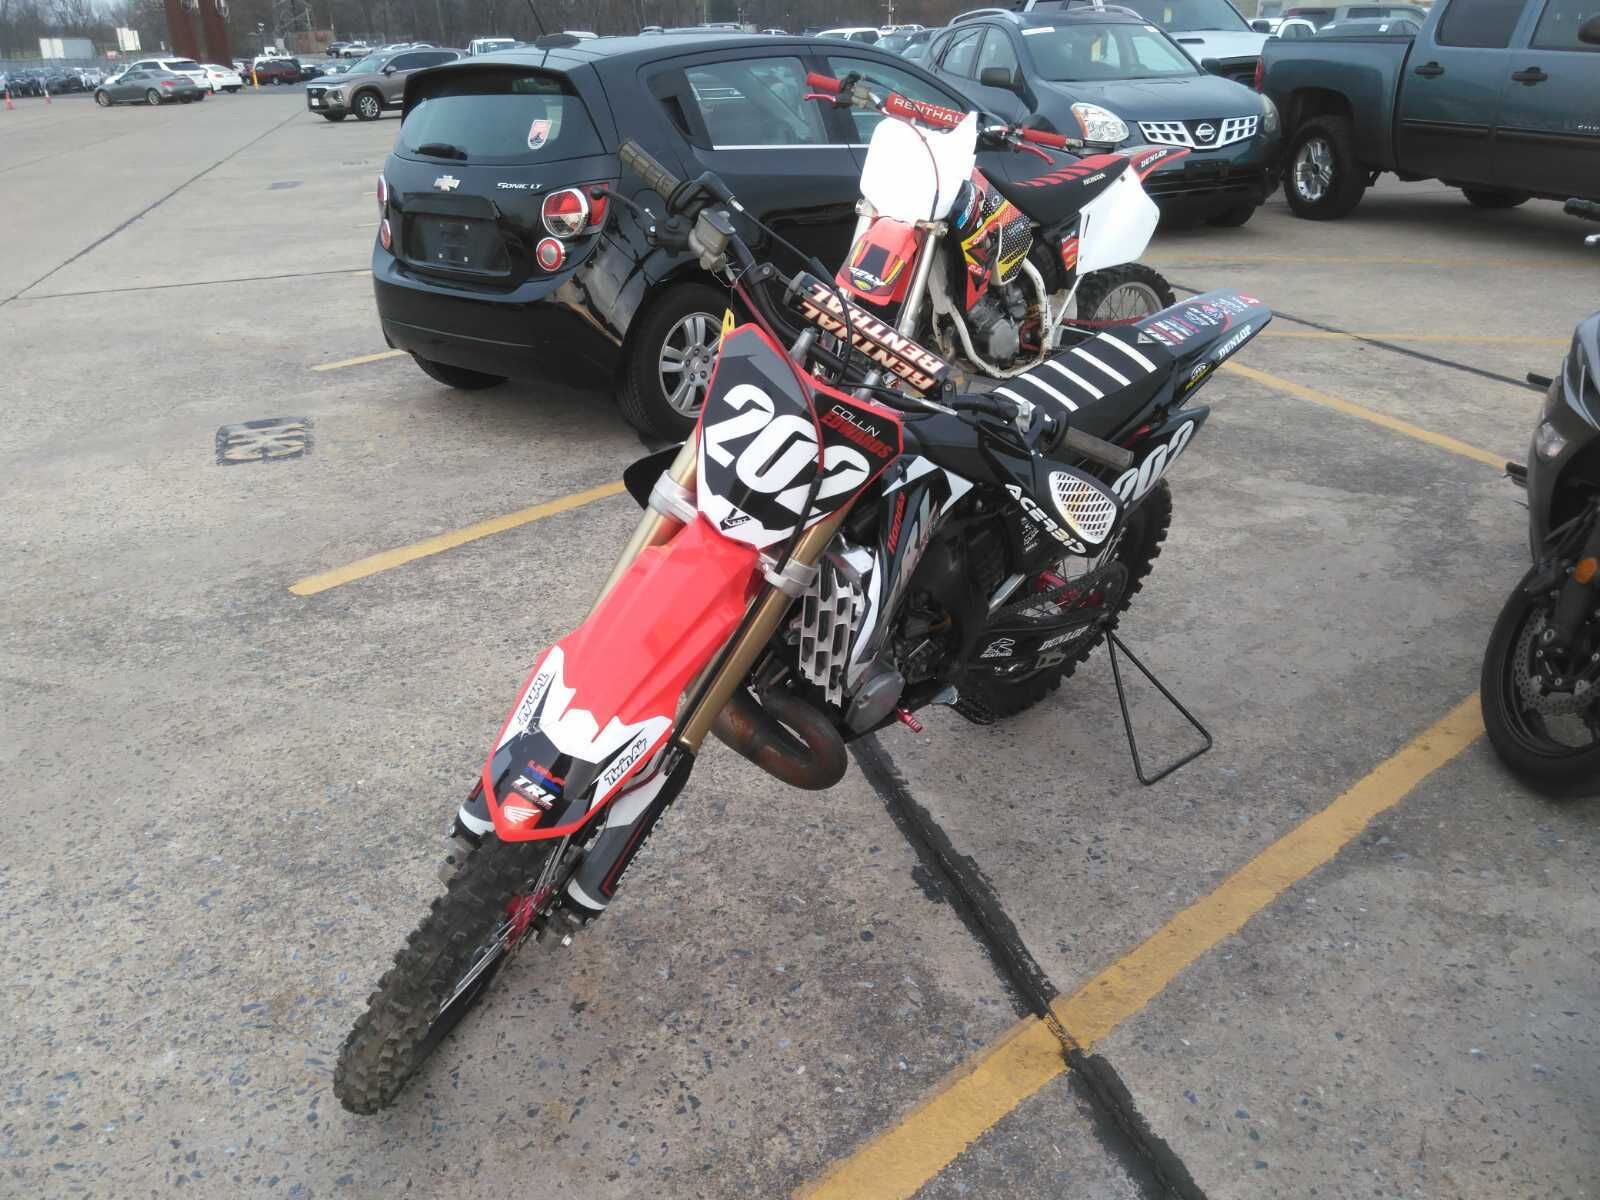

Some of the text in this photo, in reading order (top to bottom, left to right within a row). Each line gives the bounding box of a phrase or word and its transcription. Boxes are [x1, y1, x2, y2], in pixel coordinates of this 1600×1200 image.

[893, 97, 961, 124] RENTHAL
[1140, 150, 1168, 168] DUNLOP
[497, 182, 528, 190] SONIC
[812, 284, 945, 374] RENTHAL
[1217, 324, 1251, 360] DUNLOP
[831, 405, 881, 437] COLLIN
[705, 384, 870, 518] 202
[513, 775, 557, 807] TRL
